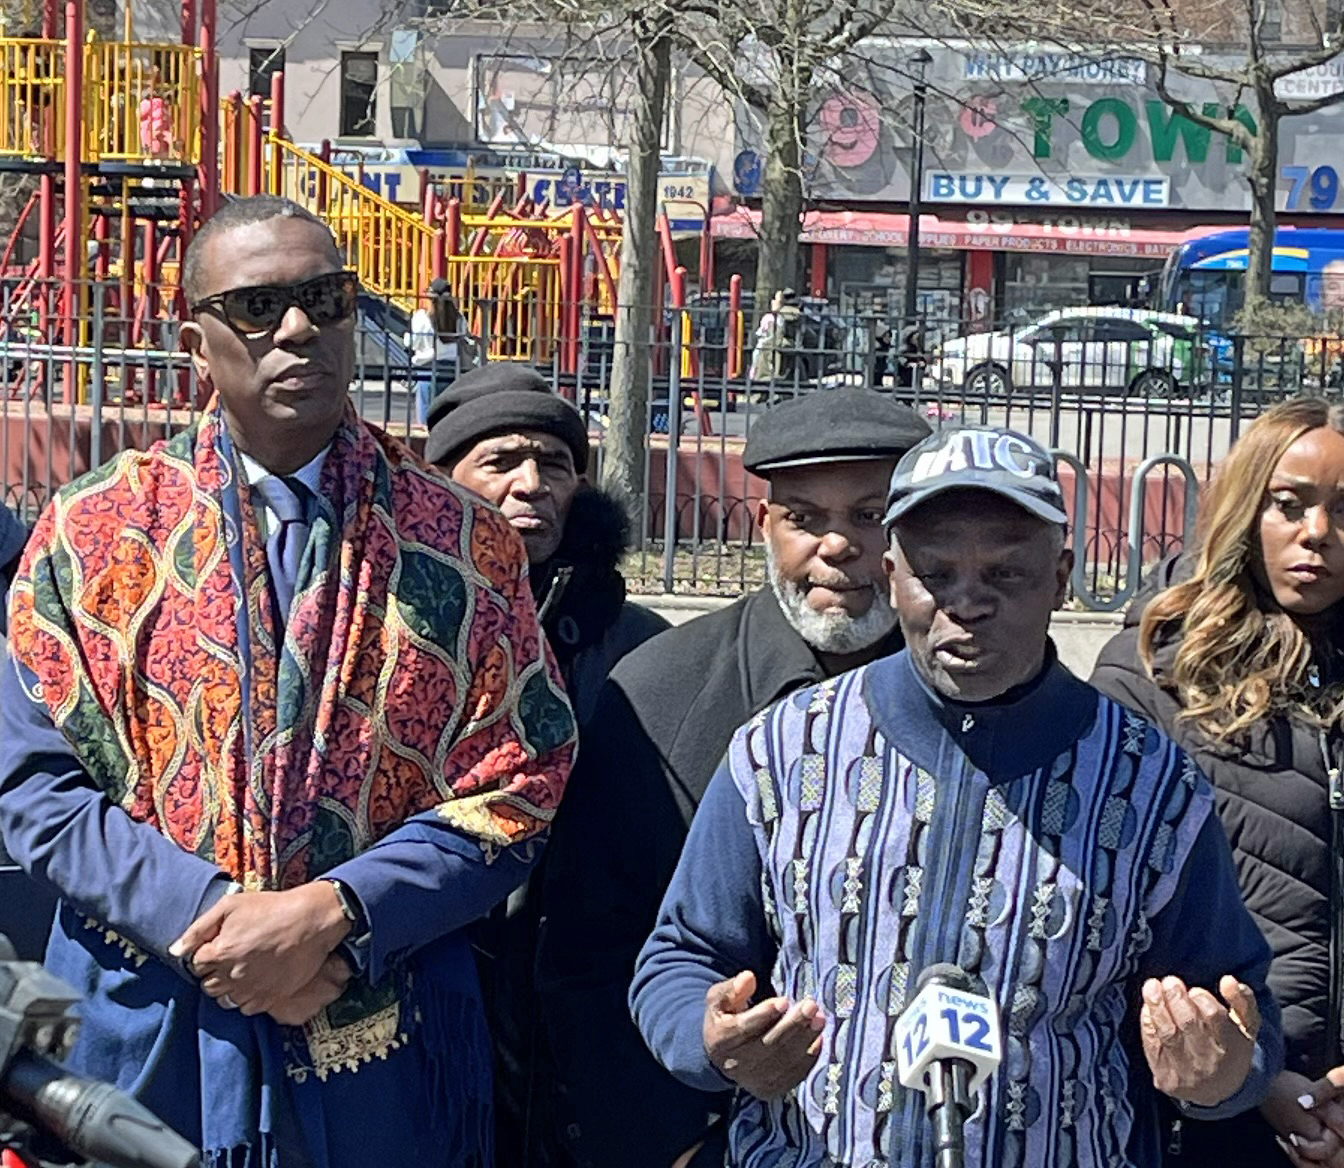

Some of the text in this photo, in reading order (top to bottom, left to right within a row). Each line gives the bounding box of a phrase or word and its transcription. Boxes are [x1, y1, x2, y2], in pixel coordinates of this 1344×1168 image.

[663, 186, 694, 198] 1942
[933, 175, 1165, 204] BUY & SAVE
[938, 991, 989, 1014] news
[940, 1008, 993, 1053] 12
